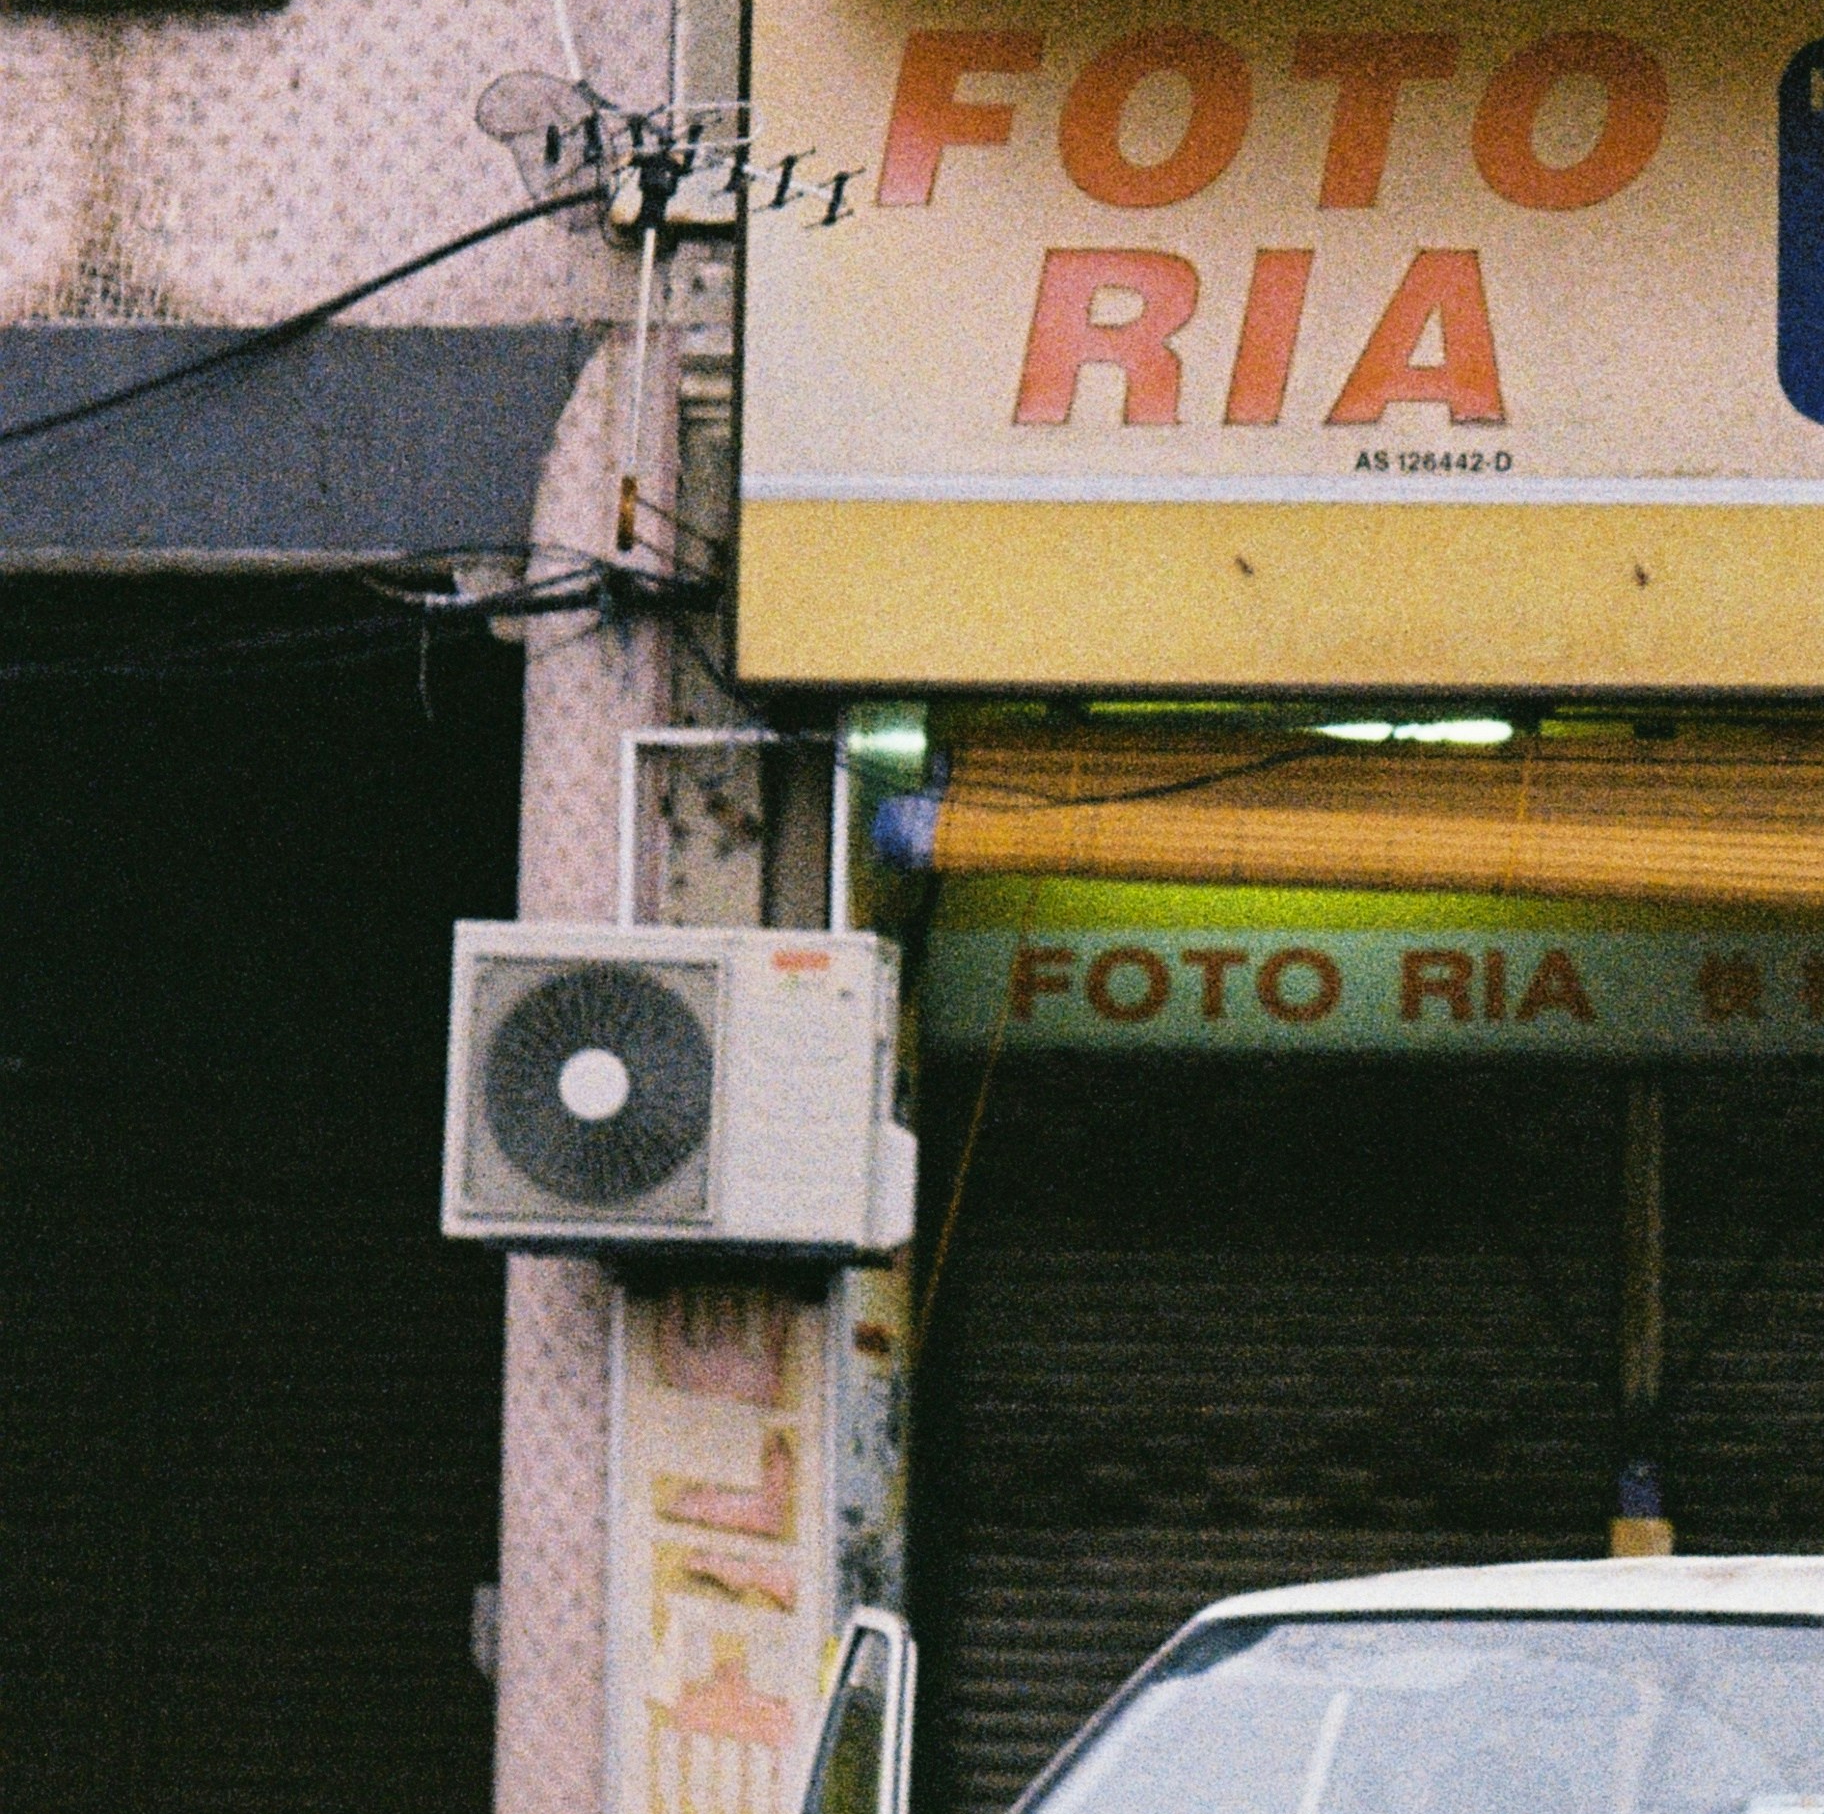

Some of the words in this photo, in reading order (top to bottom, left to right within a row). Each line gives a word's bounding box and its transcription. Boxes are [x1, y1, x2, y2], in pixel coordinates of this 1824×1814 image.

[876, 27, 1671, 211] FOTO
[1011, 246, 1508, 426] RIA
[1355, 450, 1390, 472] AS
[1012, 948, 1342, 1023] FOTO
[1400, 948, 1597, 1023] RIA
